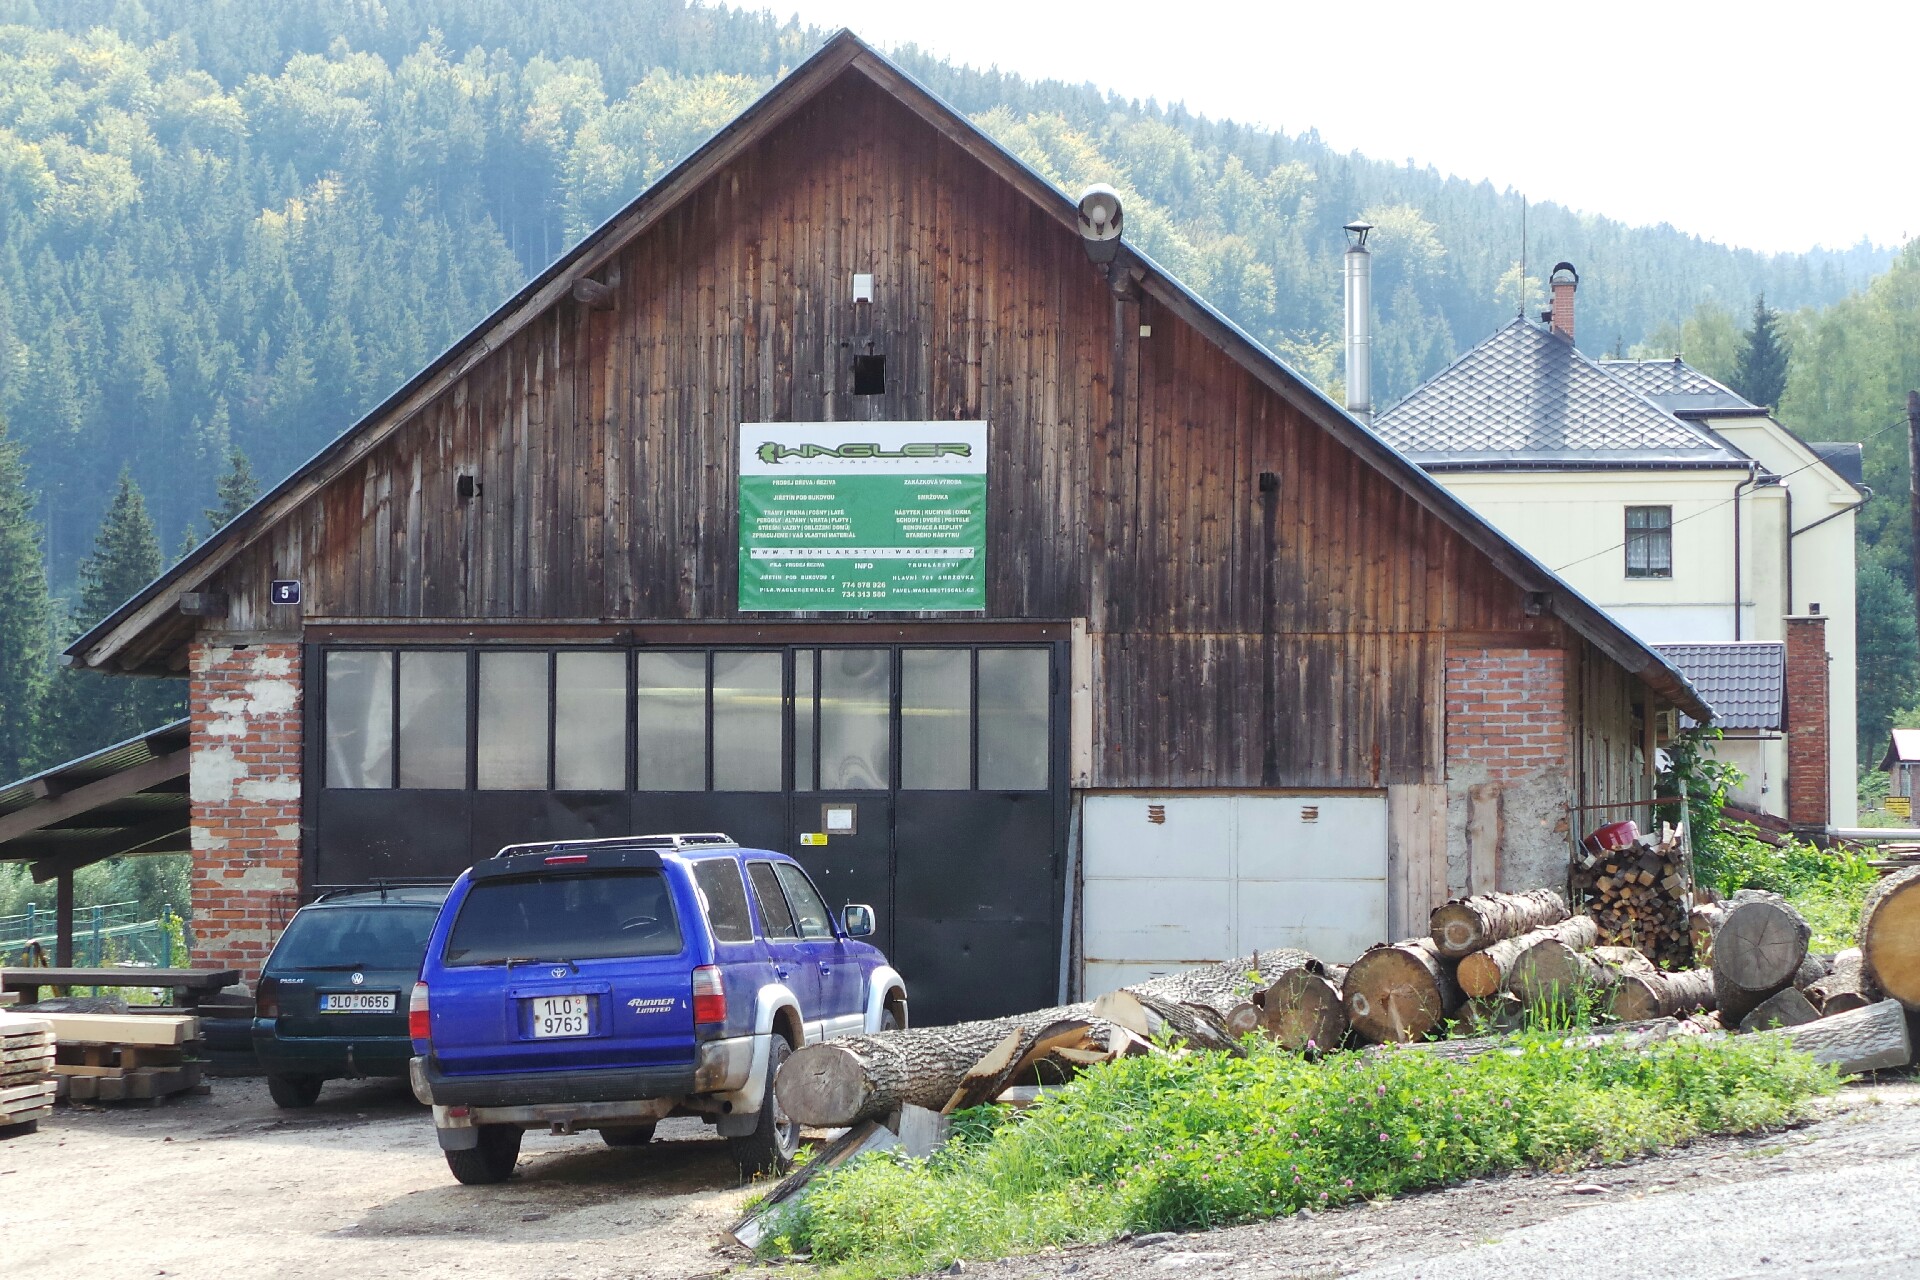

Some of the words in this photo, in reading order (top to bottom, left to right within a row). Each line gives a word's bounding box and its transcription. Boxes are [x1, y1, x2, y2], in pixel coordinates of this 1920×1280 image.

[778, 443, 972, 459] WAGLER
[281, 586, 289, 599] 5
[360, 996, 389, 1008] 0656
[544, 1017, 582, 1033] 9763
